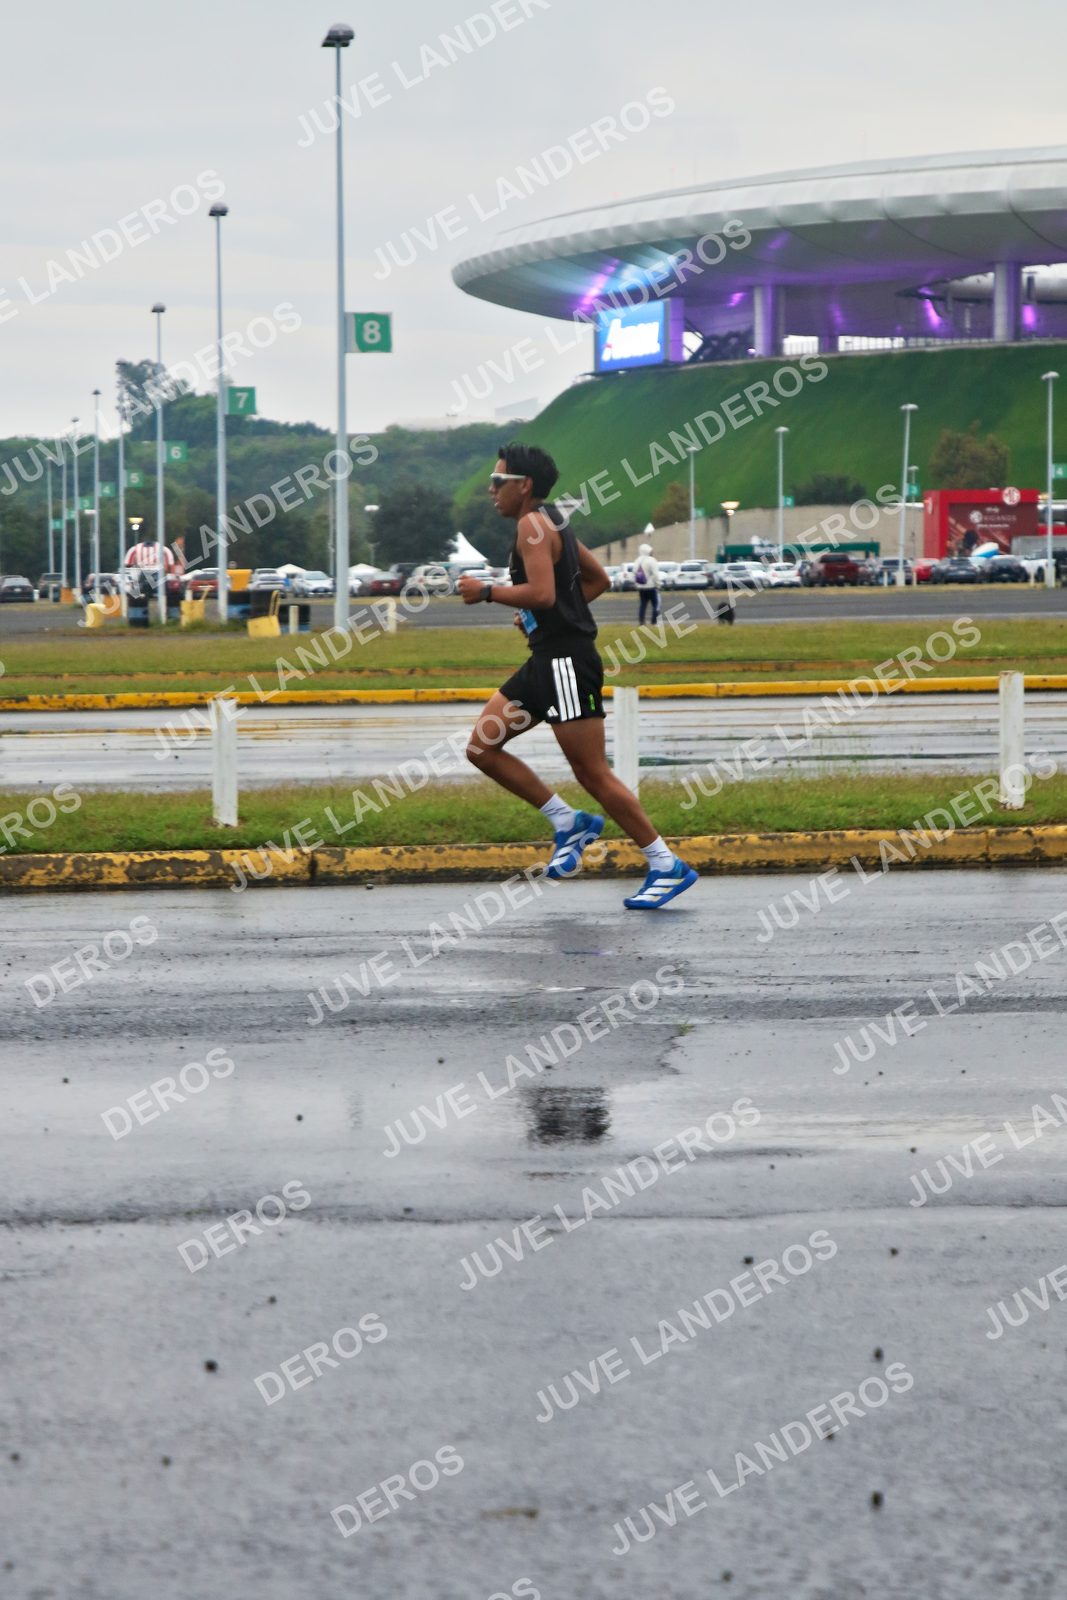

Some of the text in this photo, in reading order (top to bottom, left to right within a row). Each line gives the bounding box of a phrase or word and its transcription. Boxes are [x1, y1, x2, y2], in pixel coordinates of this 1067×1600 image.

[363, 320, 381, 344] 8
[236, 392, 248, 409] 7
[171, 446, 182, 459] 6
[131, 472, 140, 483] 5
[103, 485, 111, 494] 4
